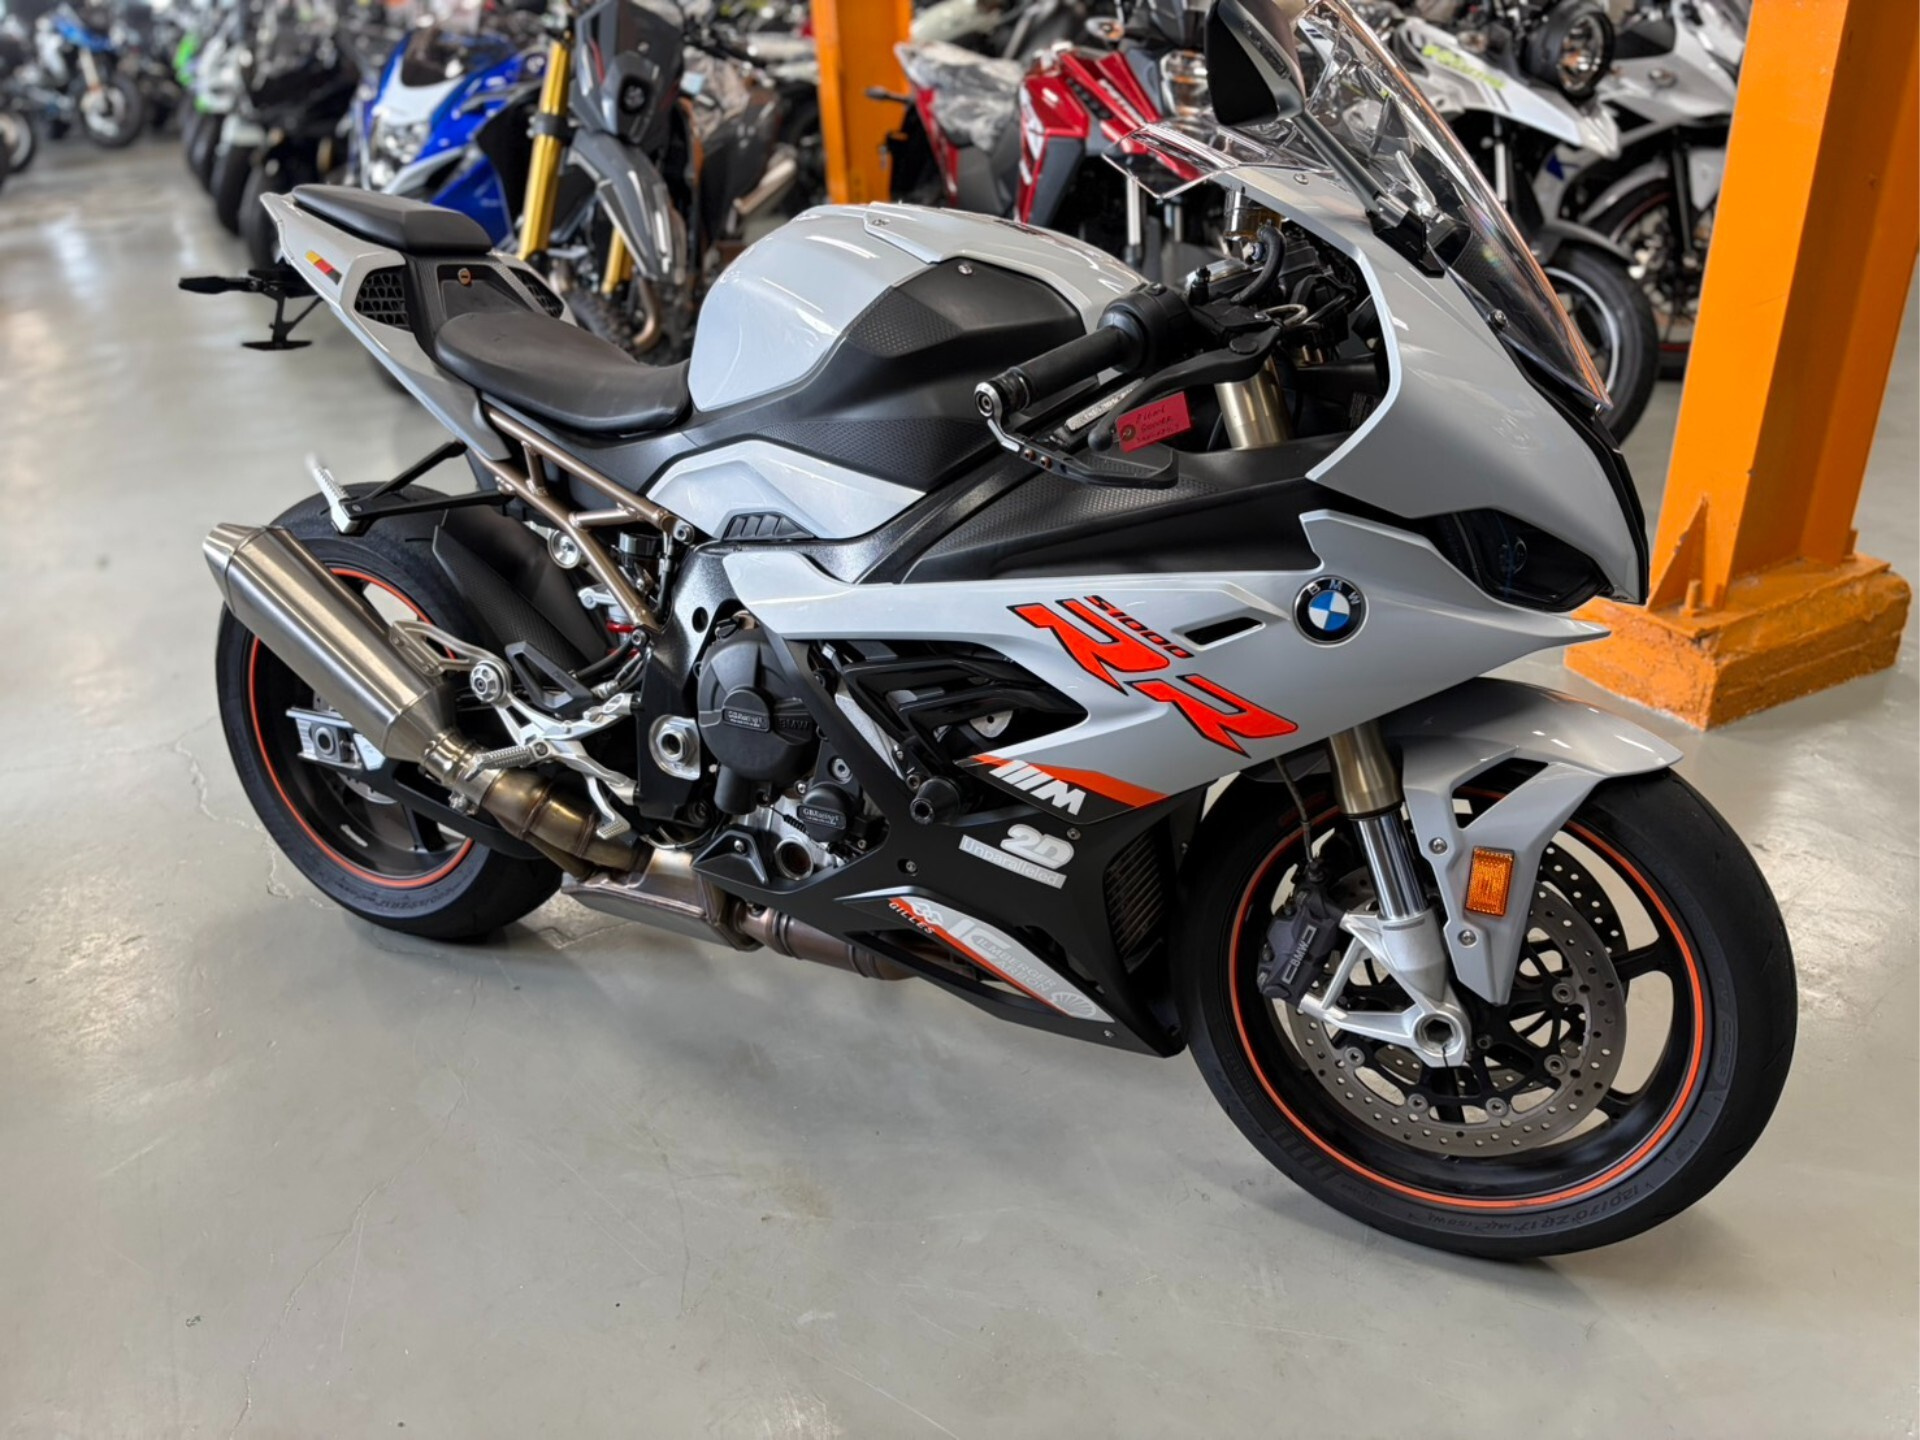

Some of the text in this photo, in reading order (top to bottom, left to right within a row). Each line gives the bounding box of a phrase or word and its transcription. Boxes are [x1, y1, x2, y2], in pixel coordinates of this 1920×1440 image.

[1307, 579, 1361, 606] BMW
[888, 901, 936, 935] GILLES
[1290, 940, 1309, 967] BMW
